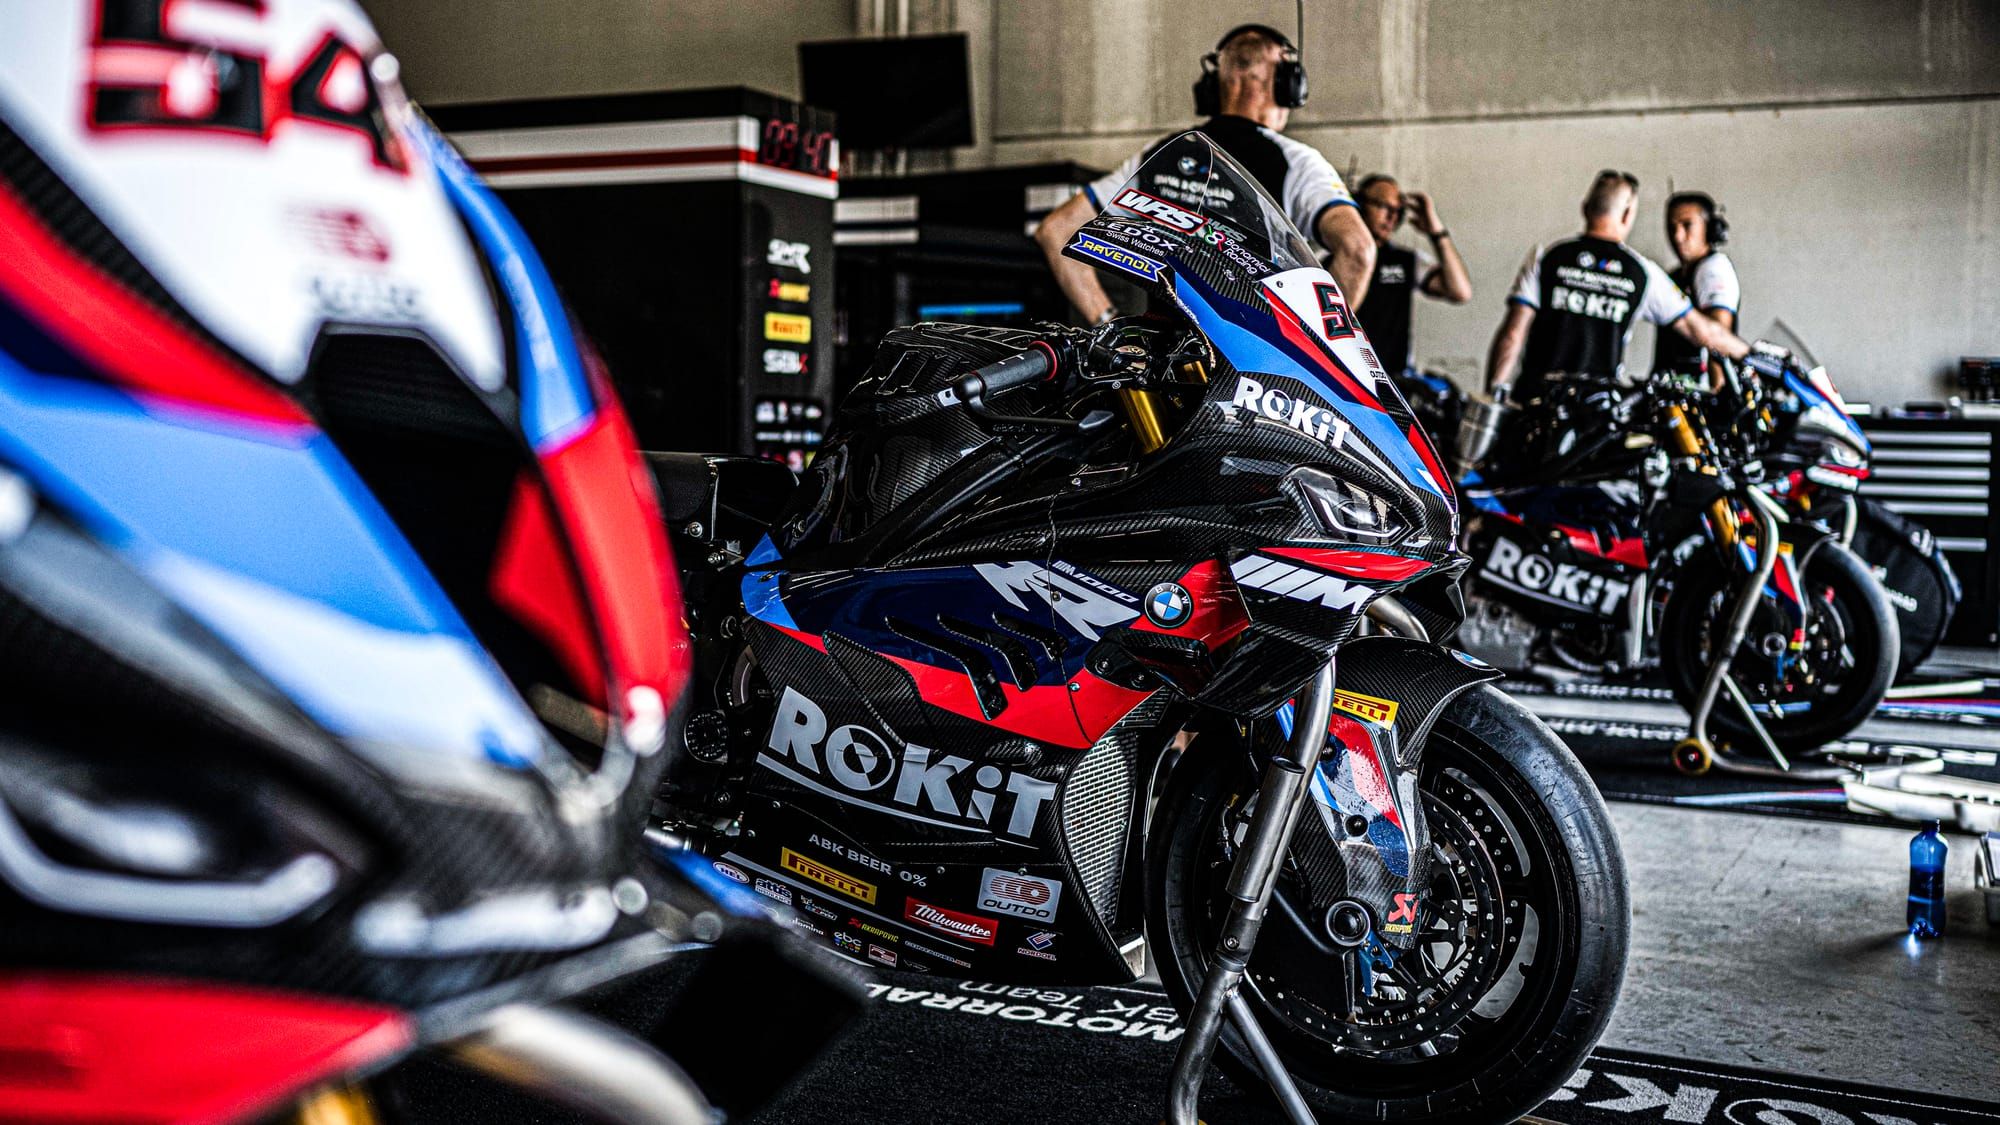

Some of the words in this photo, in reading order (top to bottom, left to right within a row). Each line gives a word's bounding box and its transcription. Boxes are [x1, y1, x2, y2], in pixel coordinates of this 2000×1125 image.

[1117, 191, 1204, 230] WRS
[1106, 222, 1179, 252] EDOX
[1106, 229, 1130, 243] Swiss
[1130, 238, 1165, 257] Watches
[1082, 240, 1152, 274] RAVENOL
[1223, 248, 1258, 275] Racing
[787, 853, 870, 899] PIRELLI
[809, 834, 844, 856] ABK
[847, 849, 892, 876] BEER
[900, 870, 927, 888] 0%
[914, 903, 992, 938] Milwaukee
[983, 899, 1050, 918] OUTDO
[833, 931, 862, 947] ebc
